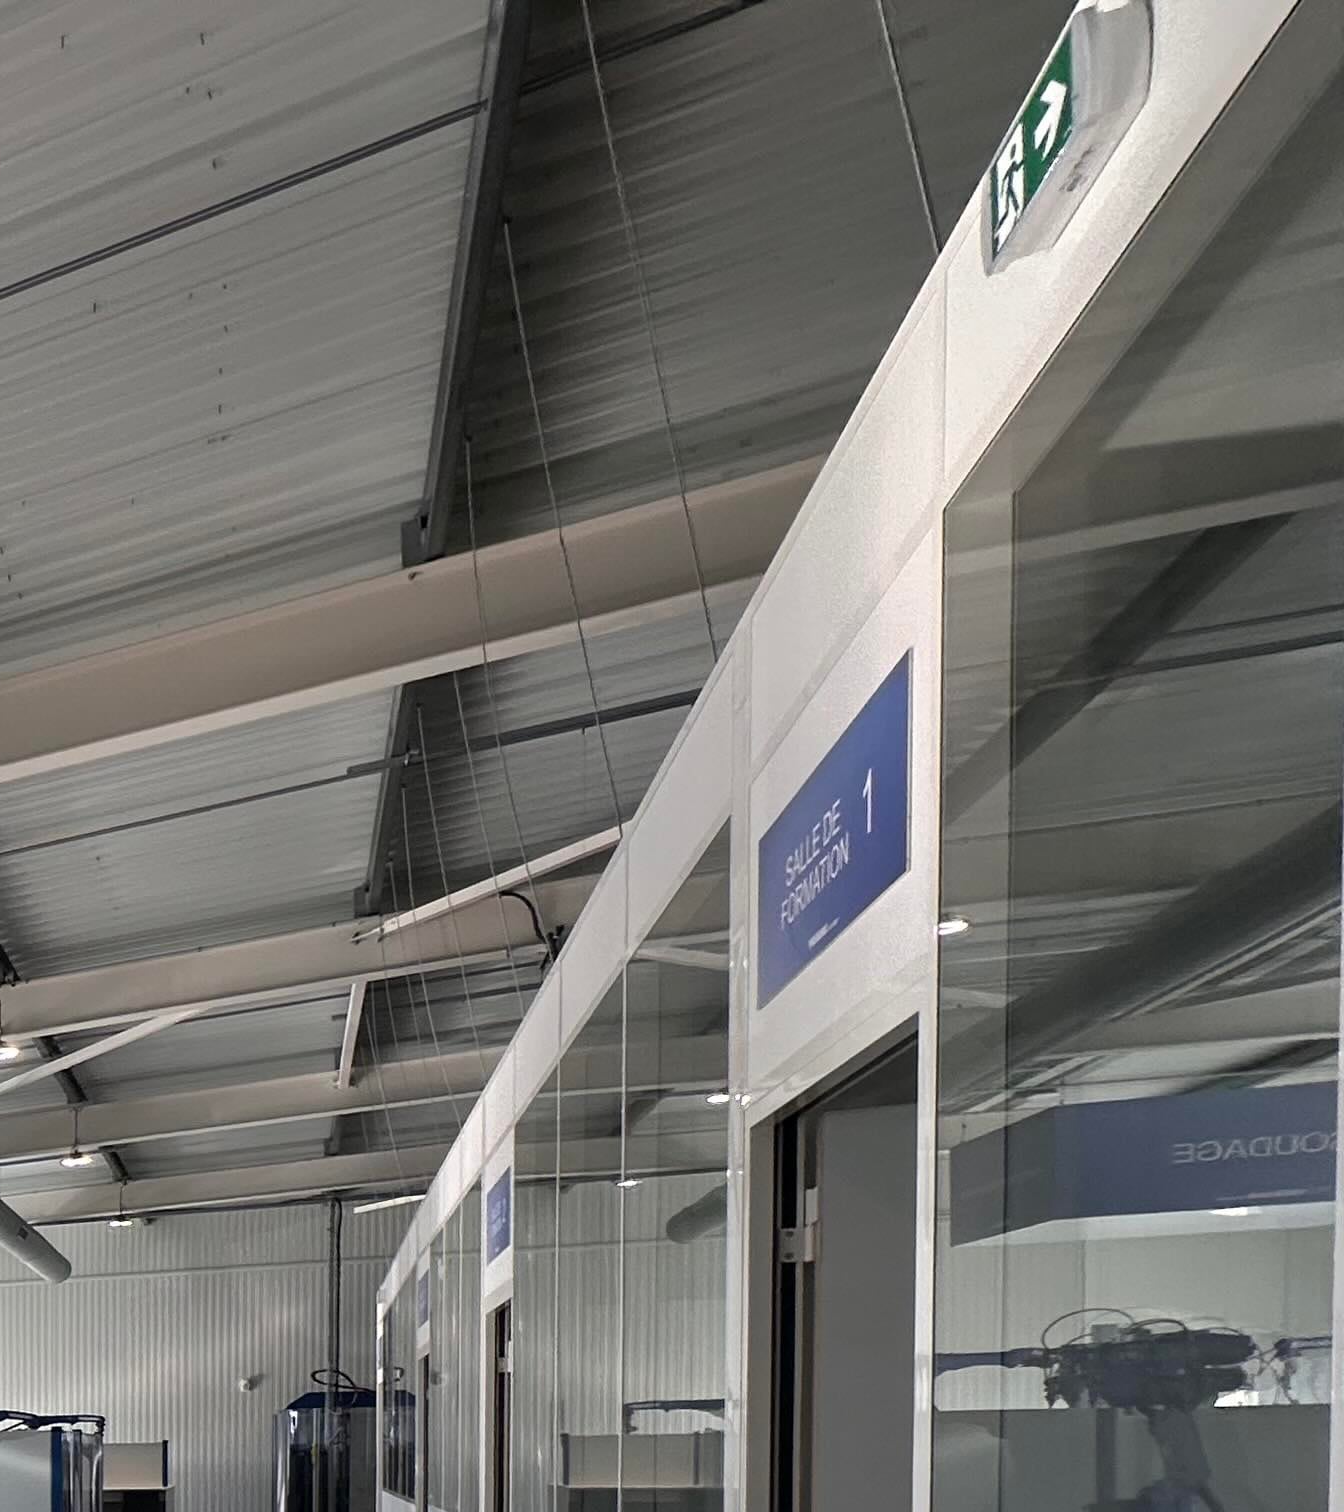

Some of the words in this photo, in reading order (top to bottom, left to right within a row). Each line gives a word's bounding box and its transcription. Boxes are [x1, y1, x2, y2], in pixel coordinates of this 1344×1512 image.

[785, 822, 822, 888] SALLE
[823, 798, 842, 847] DE
[862, 767, 872, 834] 1
[780, 831, 850, 932] FORMATION
